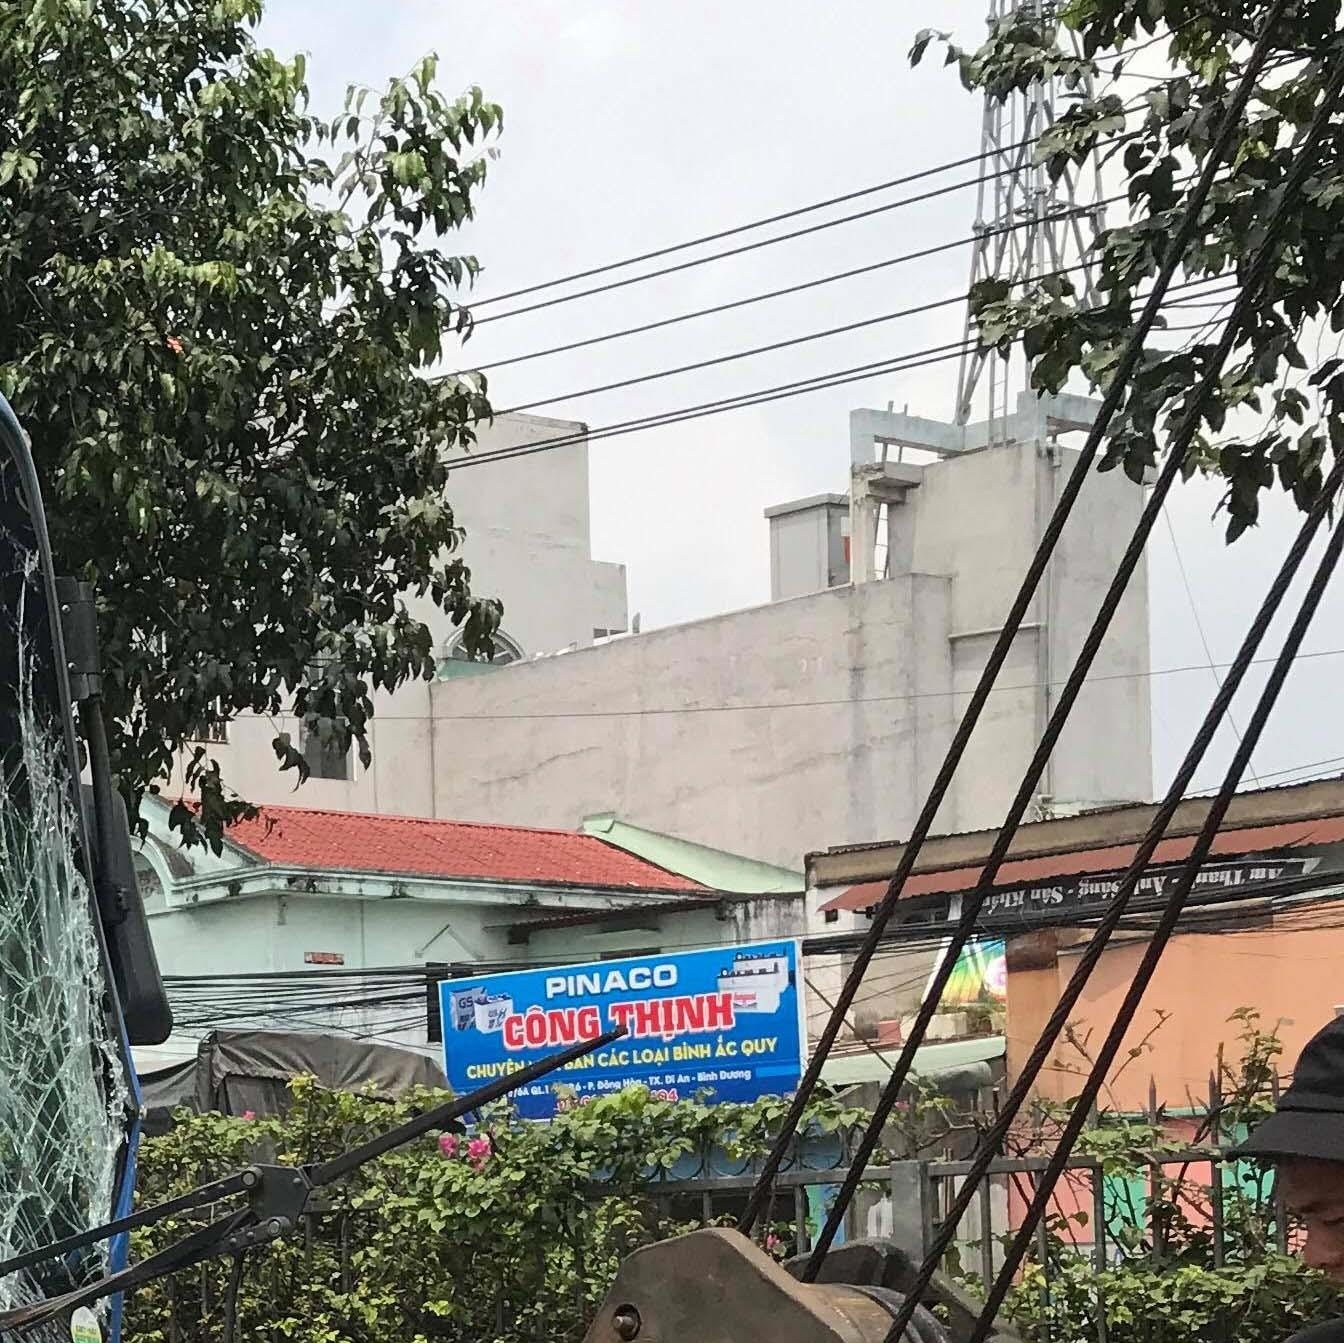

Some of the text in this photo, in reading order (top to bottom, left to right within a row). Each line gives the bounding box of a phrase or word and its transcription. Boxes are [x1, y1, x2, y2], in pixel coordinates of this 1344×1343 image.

[546, 964, 678, 999] PINACO
[503, 1005, 602, 1050] CÔNG
[609, 992, 736, 1042] THỊNH
[597, 1048, 629, 1067] CÁC
[632, 1047, 669, 1067] LOẠI
[673, 1041, 711, 1061] BÌNH
[741, 1036, 778, 1057] QUY
